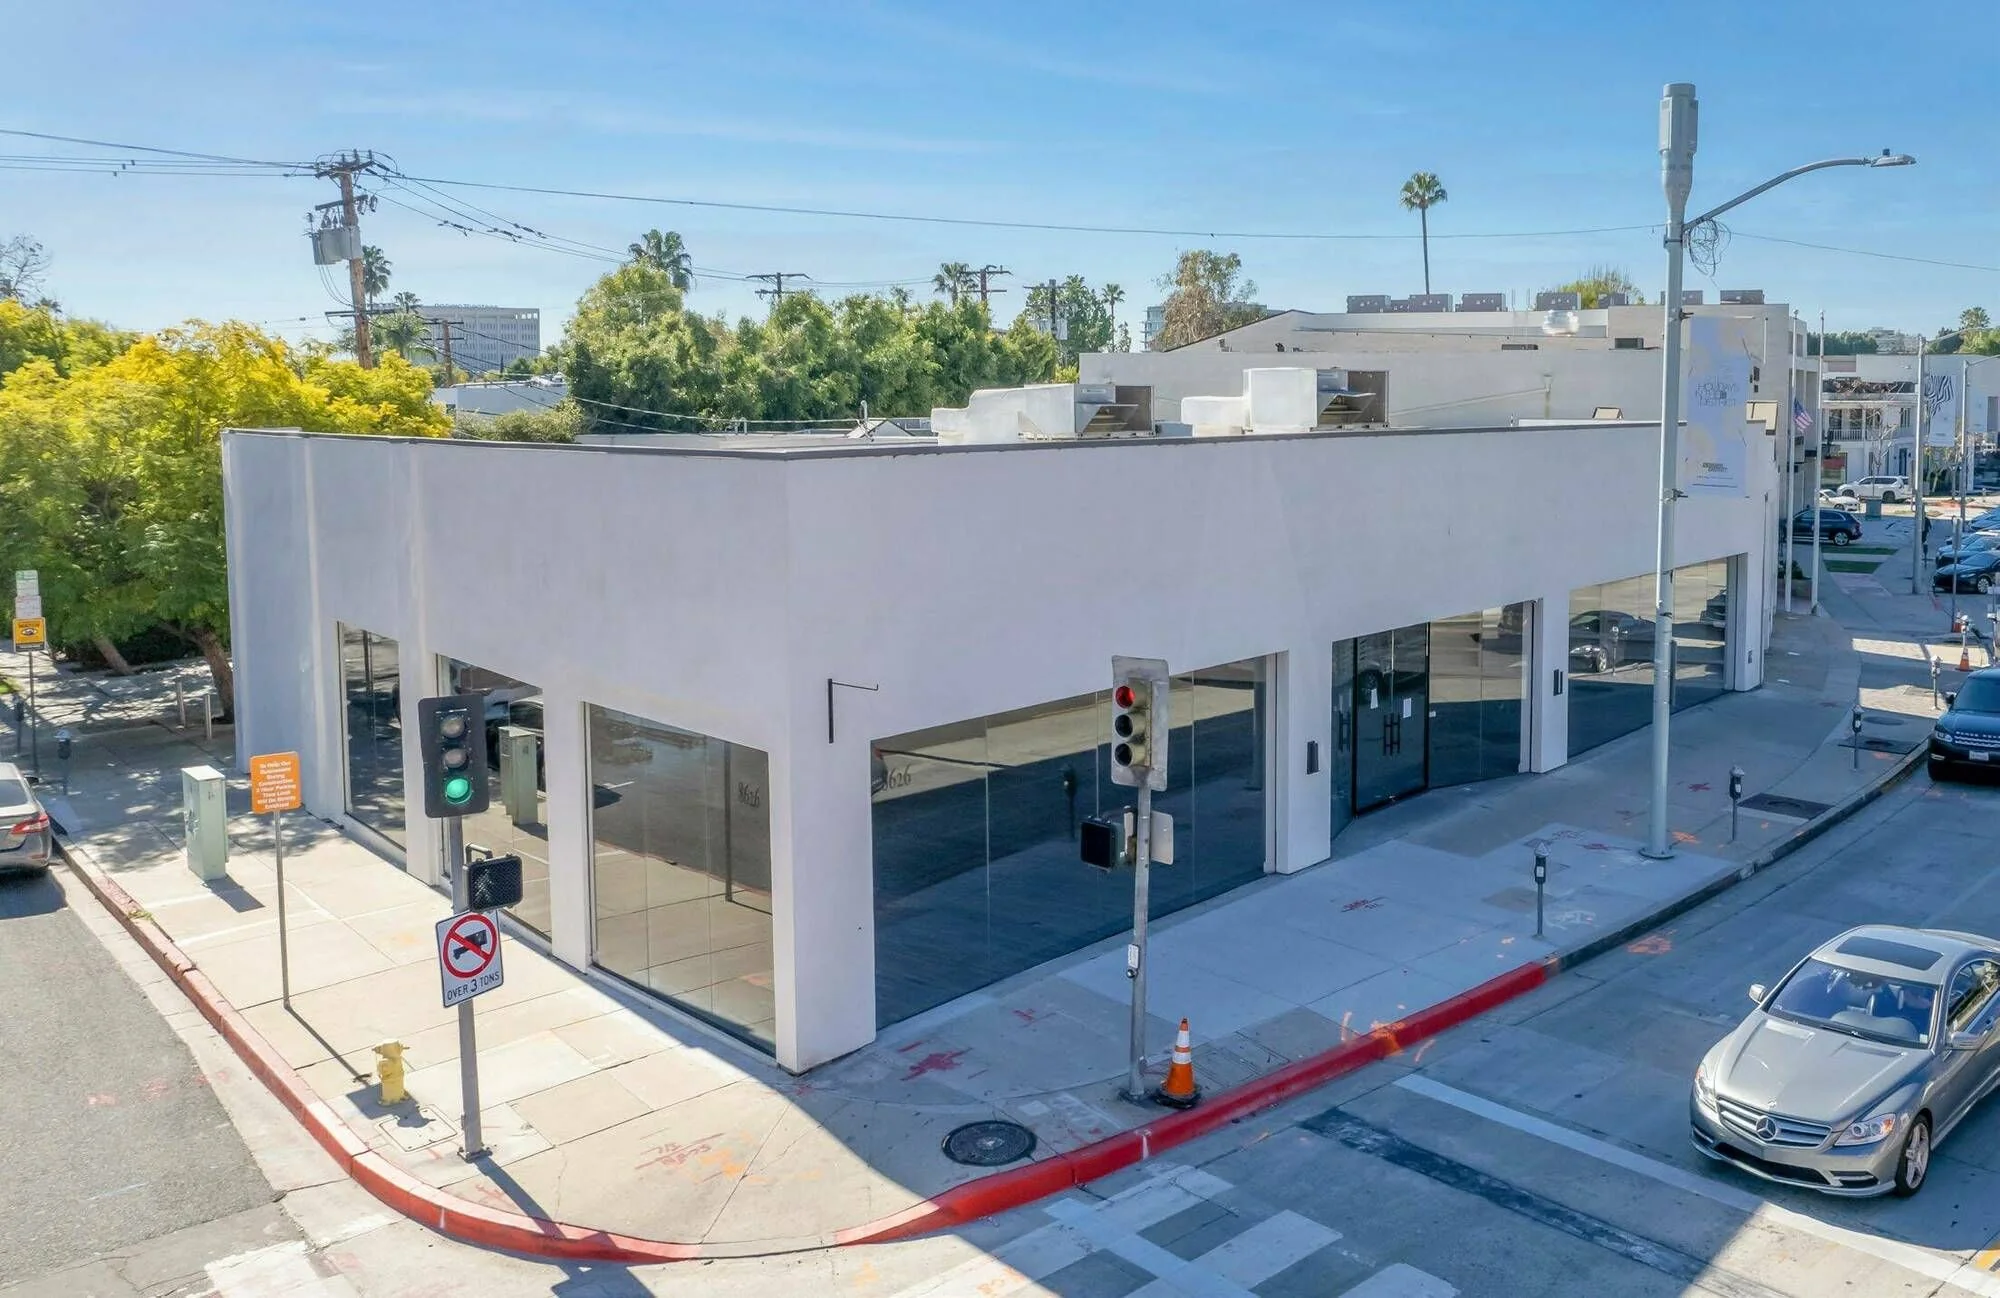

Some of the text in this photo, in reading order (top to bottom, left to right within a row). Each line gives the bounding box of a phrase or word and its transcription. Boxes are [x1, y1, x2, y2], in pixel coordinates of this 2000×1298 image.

[447, 971, 499, 1000] OVER 3 TONS
